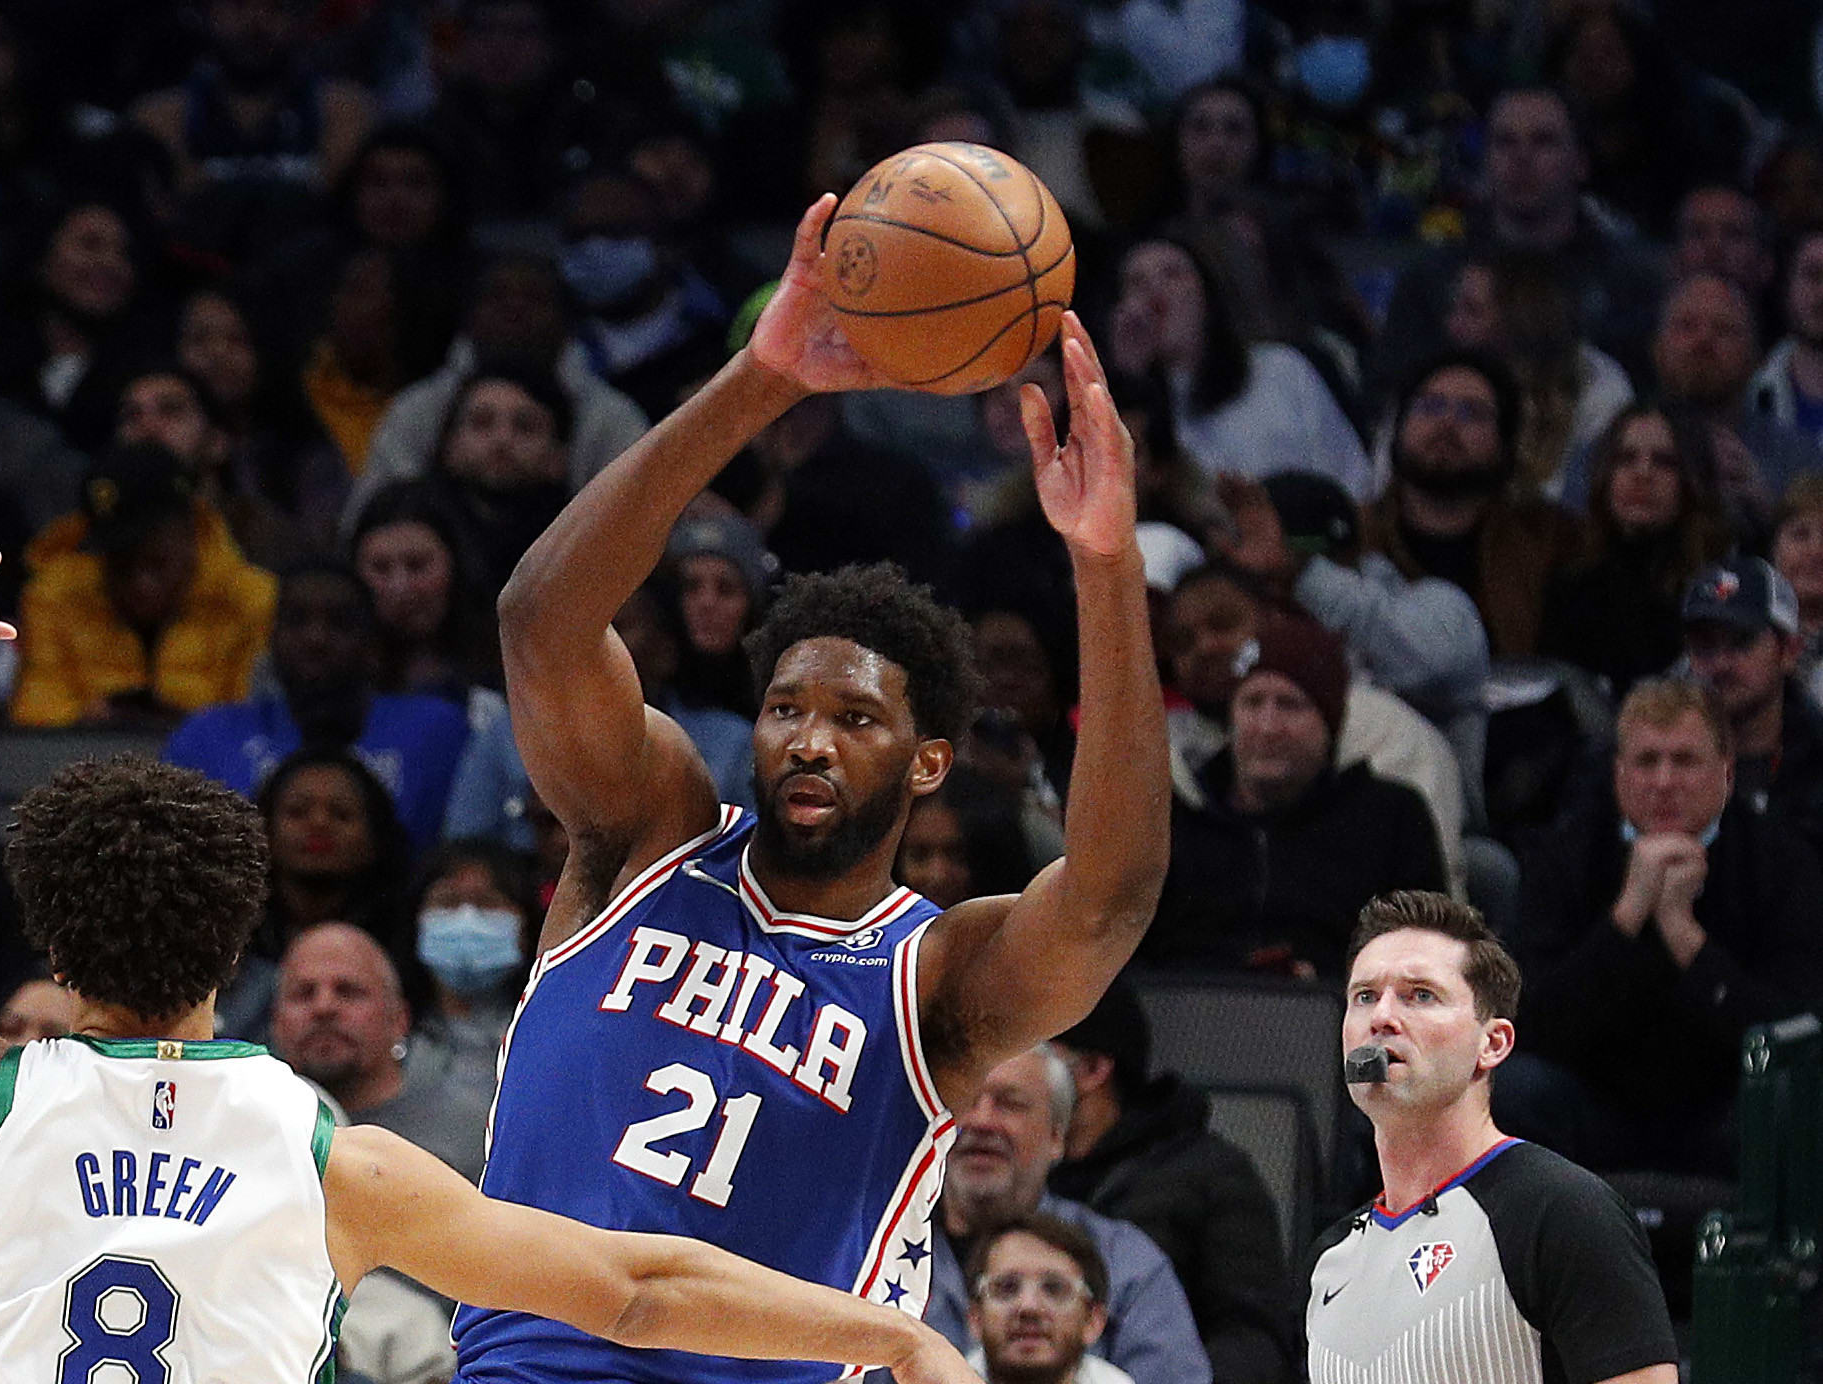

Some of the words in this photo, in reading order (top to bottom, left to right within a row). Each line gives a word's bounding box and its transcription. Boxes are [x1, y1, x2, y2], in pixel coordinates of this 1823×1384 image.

[810, 952, 889, 968] crypto.com
[598, 926, 868, 1114] PHILA
[75, 1150, 238, 1226] GREEN
[610, 1062, 763, 1209] 21
